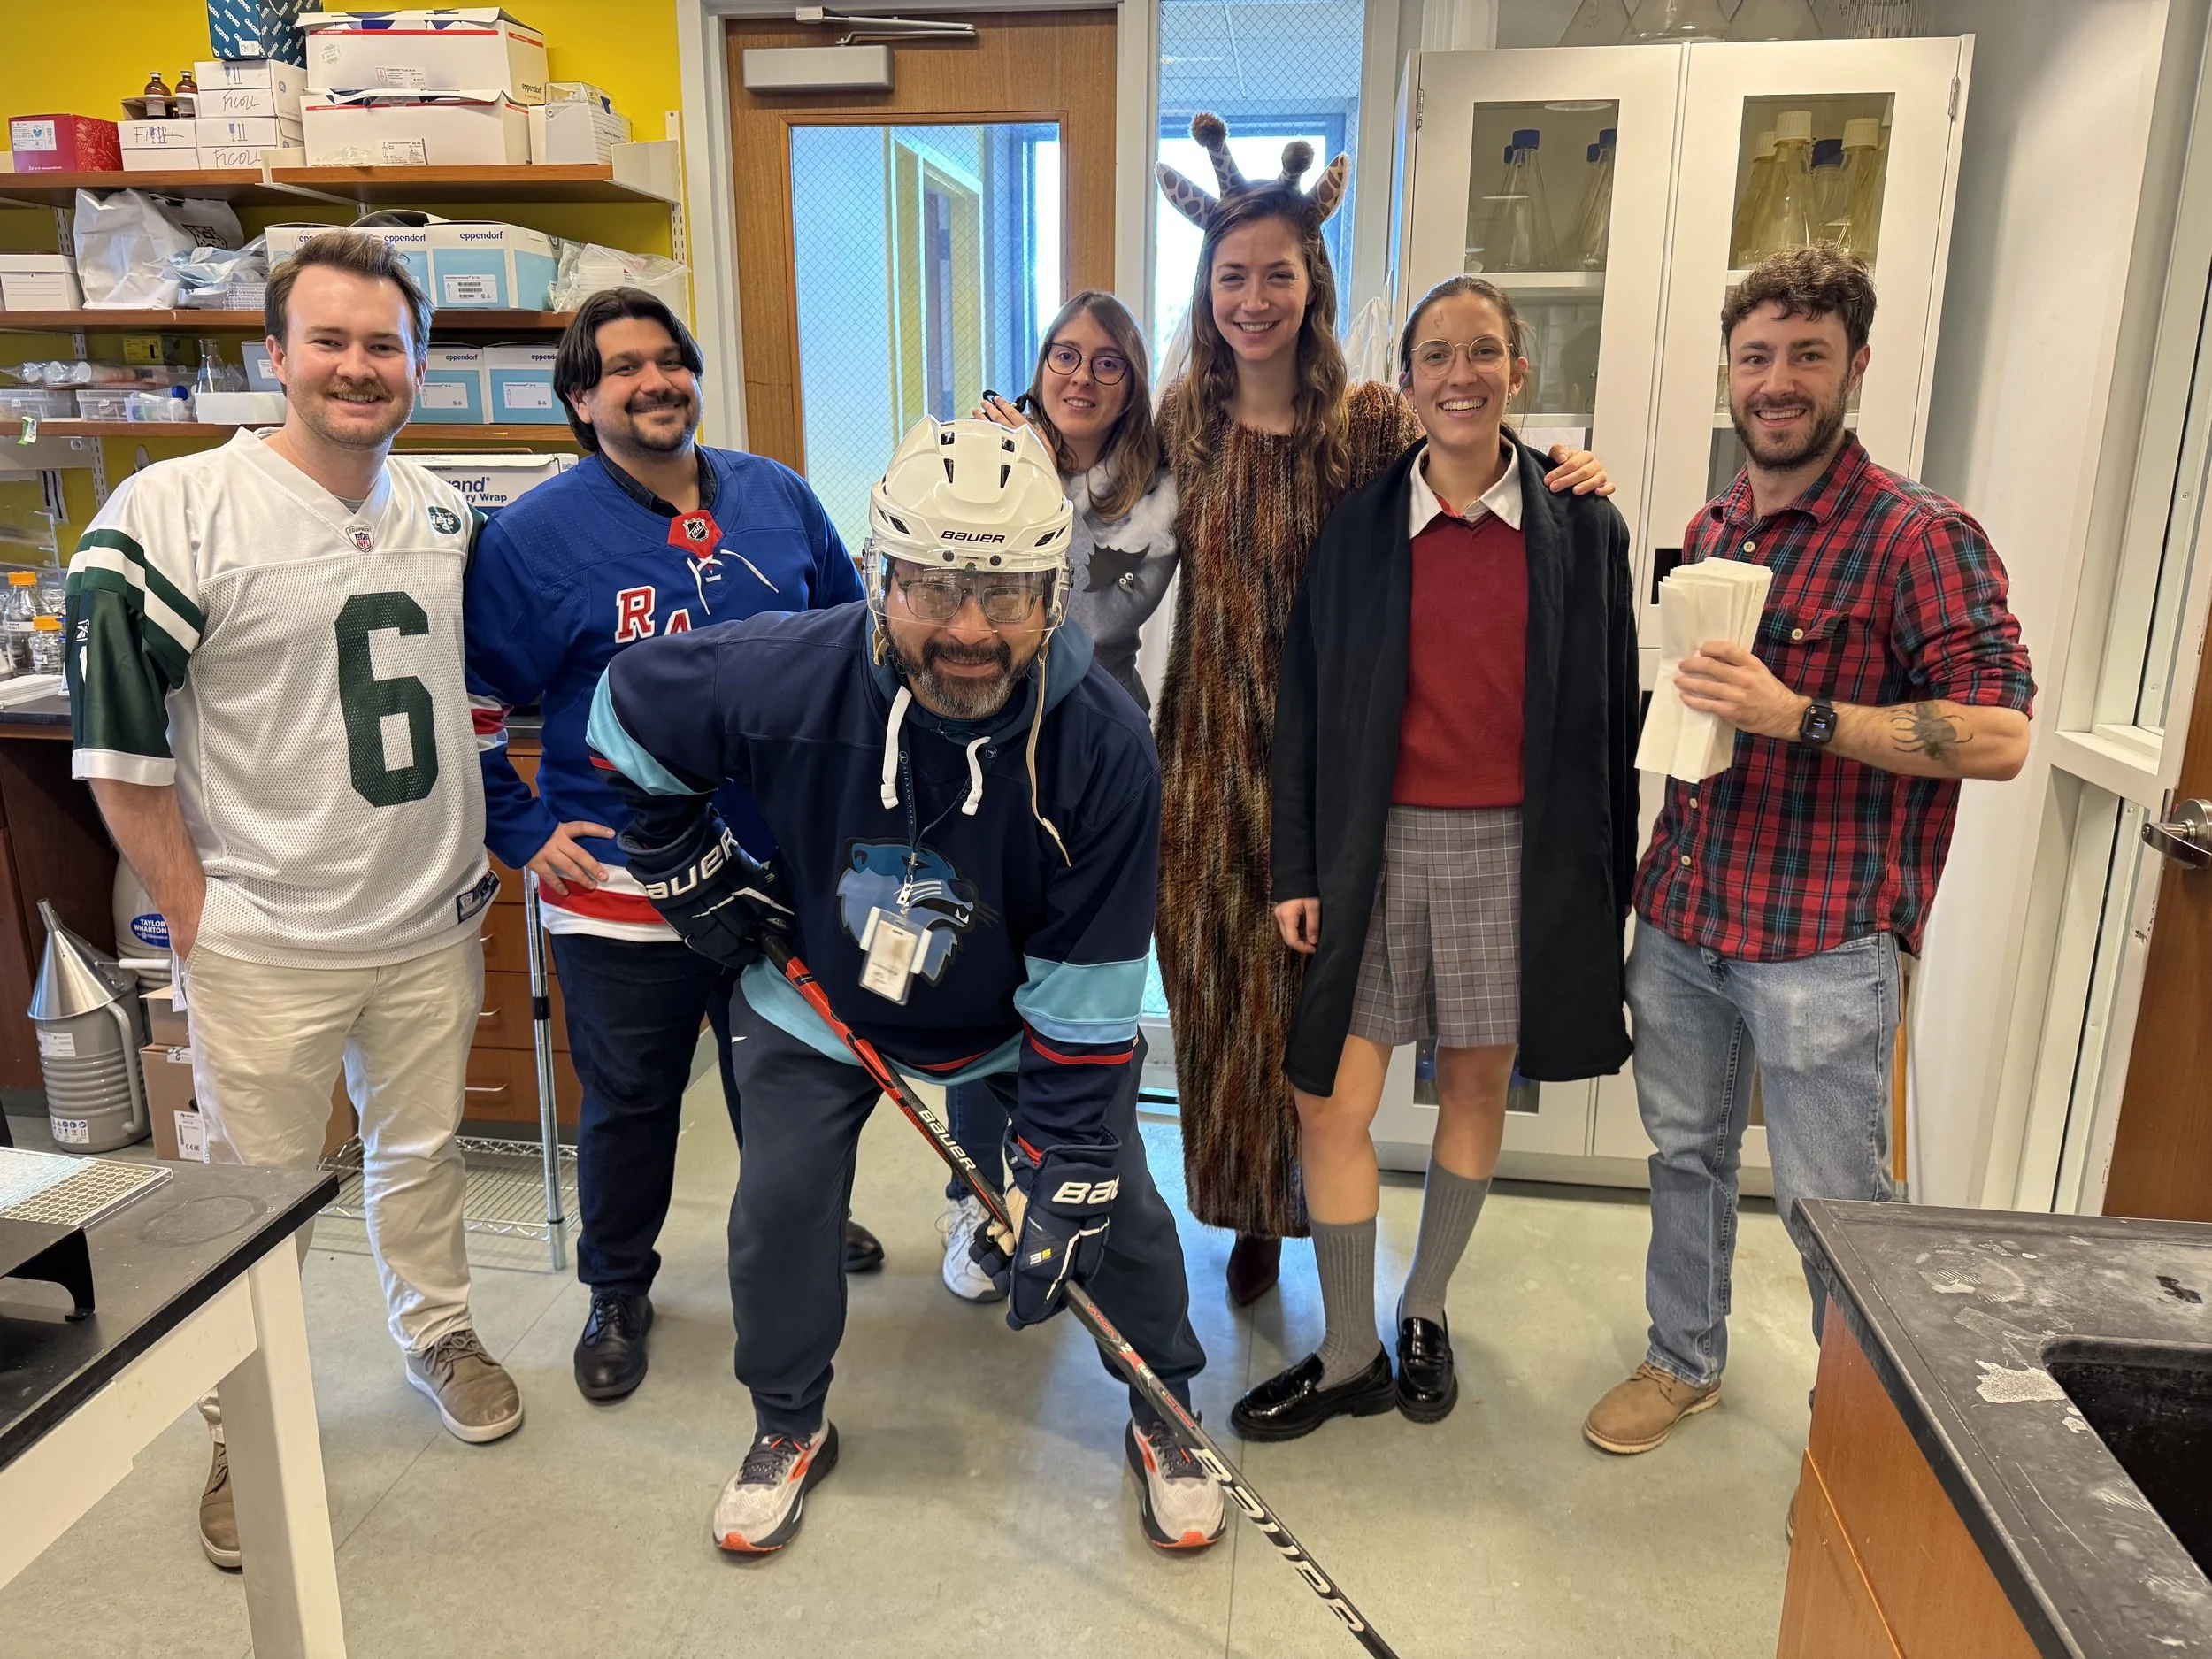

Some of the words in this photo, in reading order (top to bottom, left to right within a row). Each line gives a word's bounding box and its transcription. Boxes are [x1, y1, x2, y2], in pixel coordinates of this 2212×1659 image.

[237, 0, 251, 12] QIAG
[223, 8, 241, 27] QIAGEN
[213, 23, 230, 42] QIAGEN
[244, 18, 262, 37] QIAGEN
[234, 33, 243, 42] QIA
[521, 82, 542, 95] eppendorf
[459, 230, 503, 242] eppendorf
[445, 353, 478, 362] eppendorf
[479, 493, 508, 504] Wrap
[691, 523, 703, 538] NHL
[357, 540, 371, 549] NFL
[614, 585, 692, 644] RA
[334, 590, 440, 808] 6
[645, 826, 739, 901] AUER
[133, 923, 168, 934] WHARTON
[140, 918, 166, 927] TAYLOR
[1087, 1302, 1117, 1339] VAPOR
